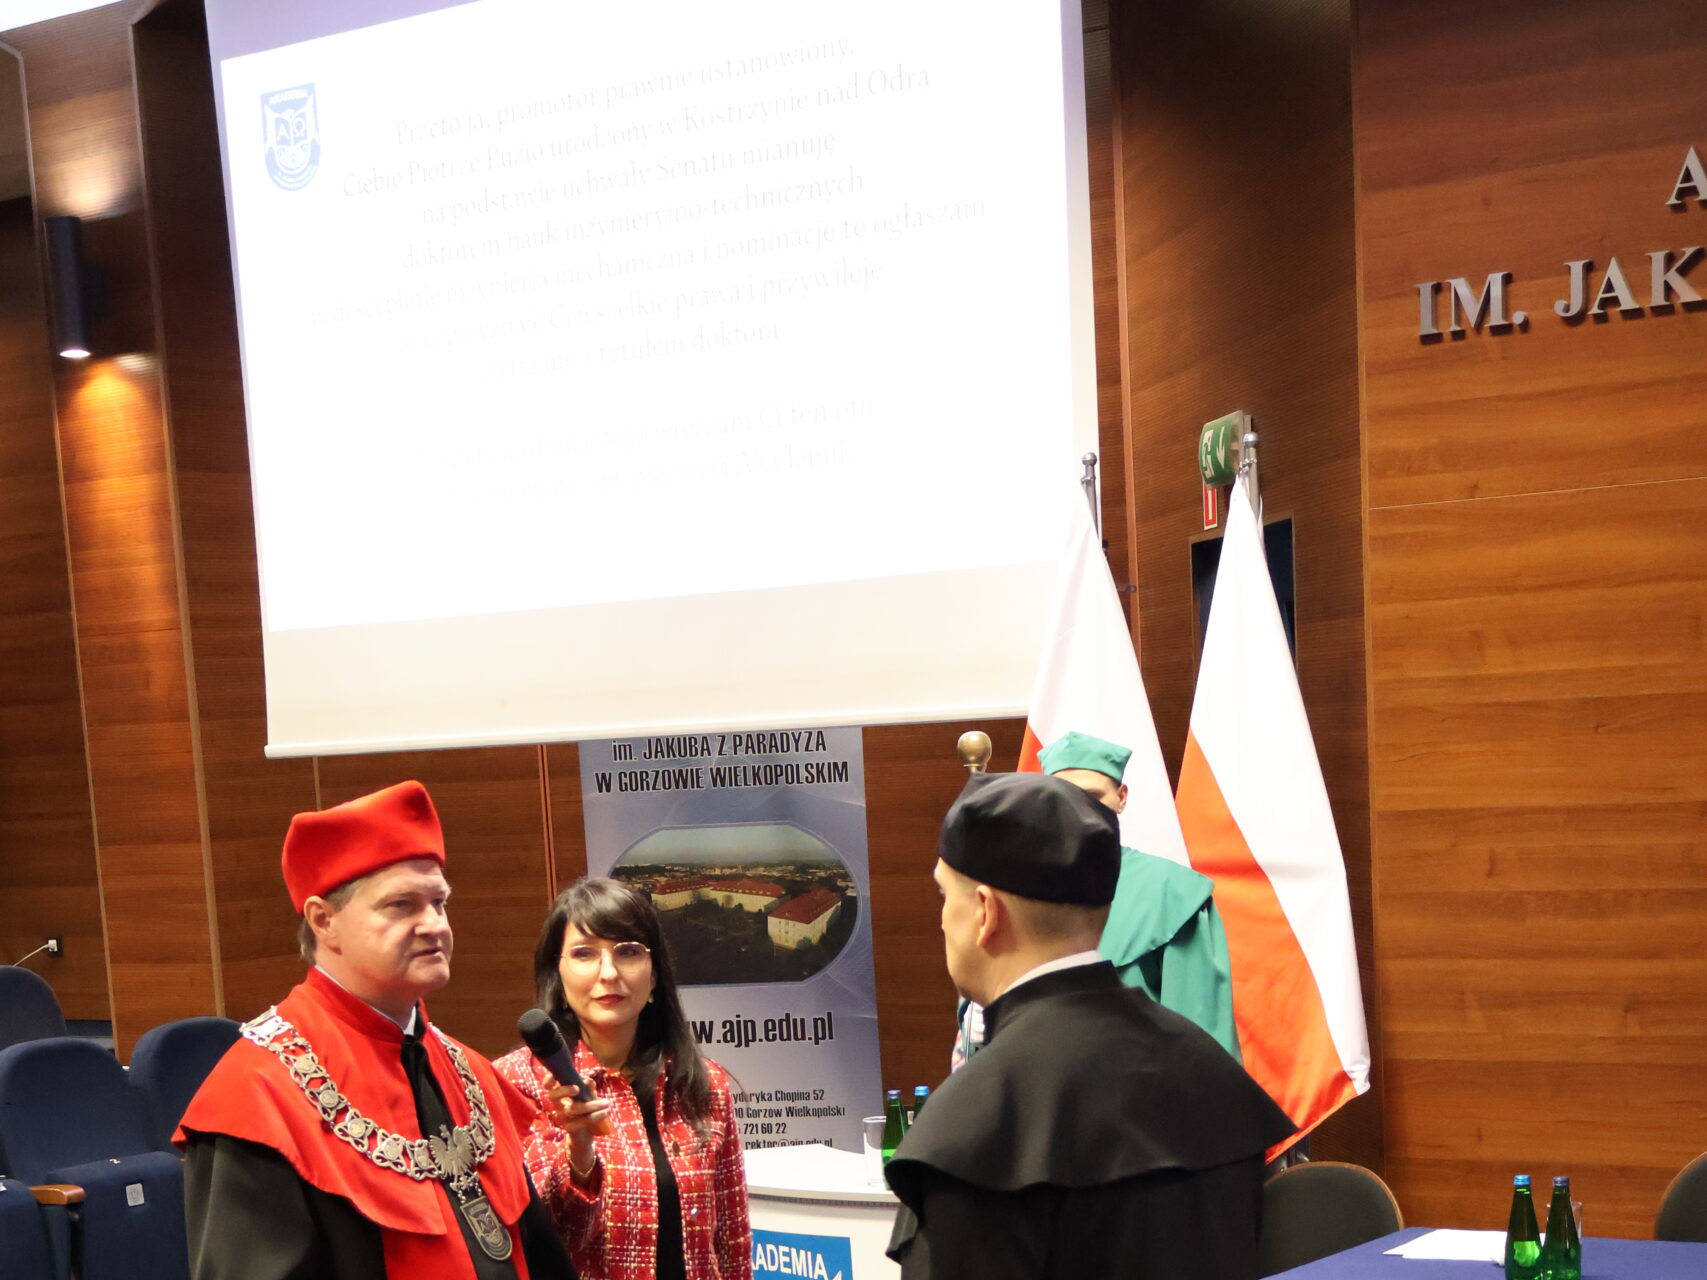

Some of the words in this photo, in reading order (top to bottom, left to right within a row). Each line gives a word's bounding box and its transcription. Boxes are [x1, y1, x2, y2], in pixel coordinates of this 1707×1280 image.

[817, 71, 860, 106] nad
[1665, 145, 1707, 206] A
[1414, 271, 1529, 337] IM.
[1553, 246, 1706, 320] JAK
[612, 739, 638, 762] im.
[643, 735, 712, 760] JAKUBA
[717, 734, 727, 756] Z
[595, 771, 612, 793] W
[618, 767, 705, 792] GORZOWIE
[710, 761, 849, 789] WIELKOPOLSKIM
[688, 1012, 834, 1048] w.ajp.edu.pl
[774, 1089, 811, 1103] Chopina
[813, 1088, 825, 1101] 52
[785, 1105, 846, 1119] Wielkopolski
[743, 1123, 759, 1135] 721
[761, 1123, 773, 1134] 60
[775, 1122, 787, 1134] 22
